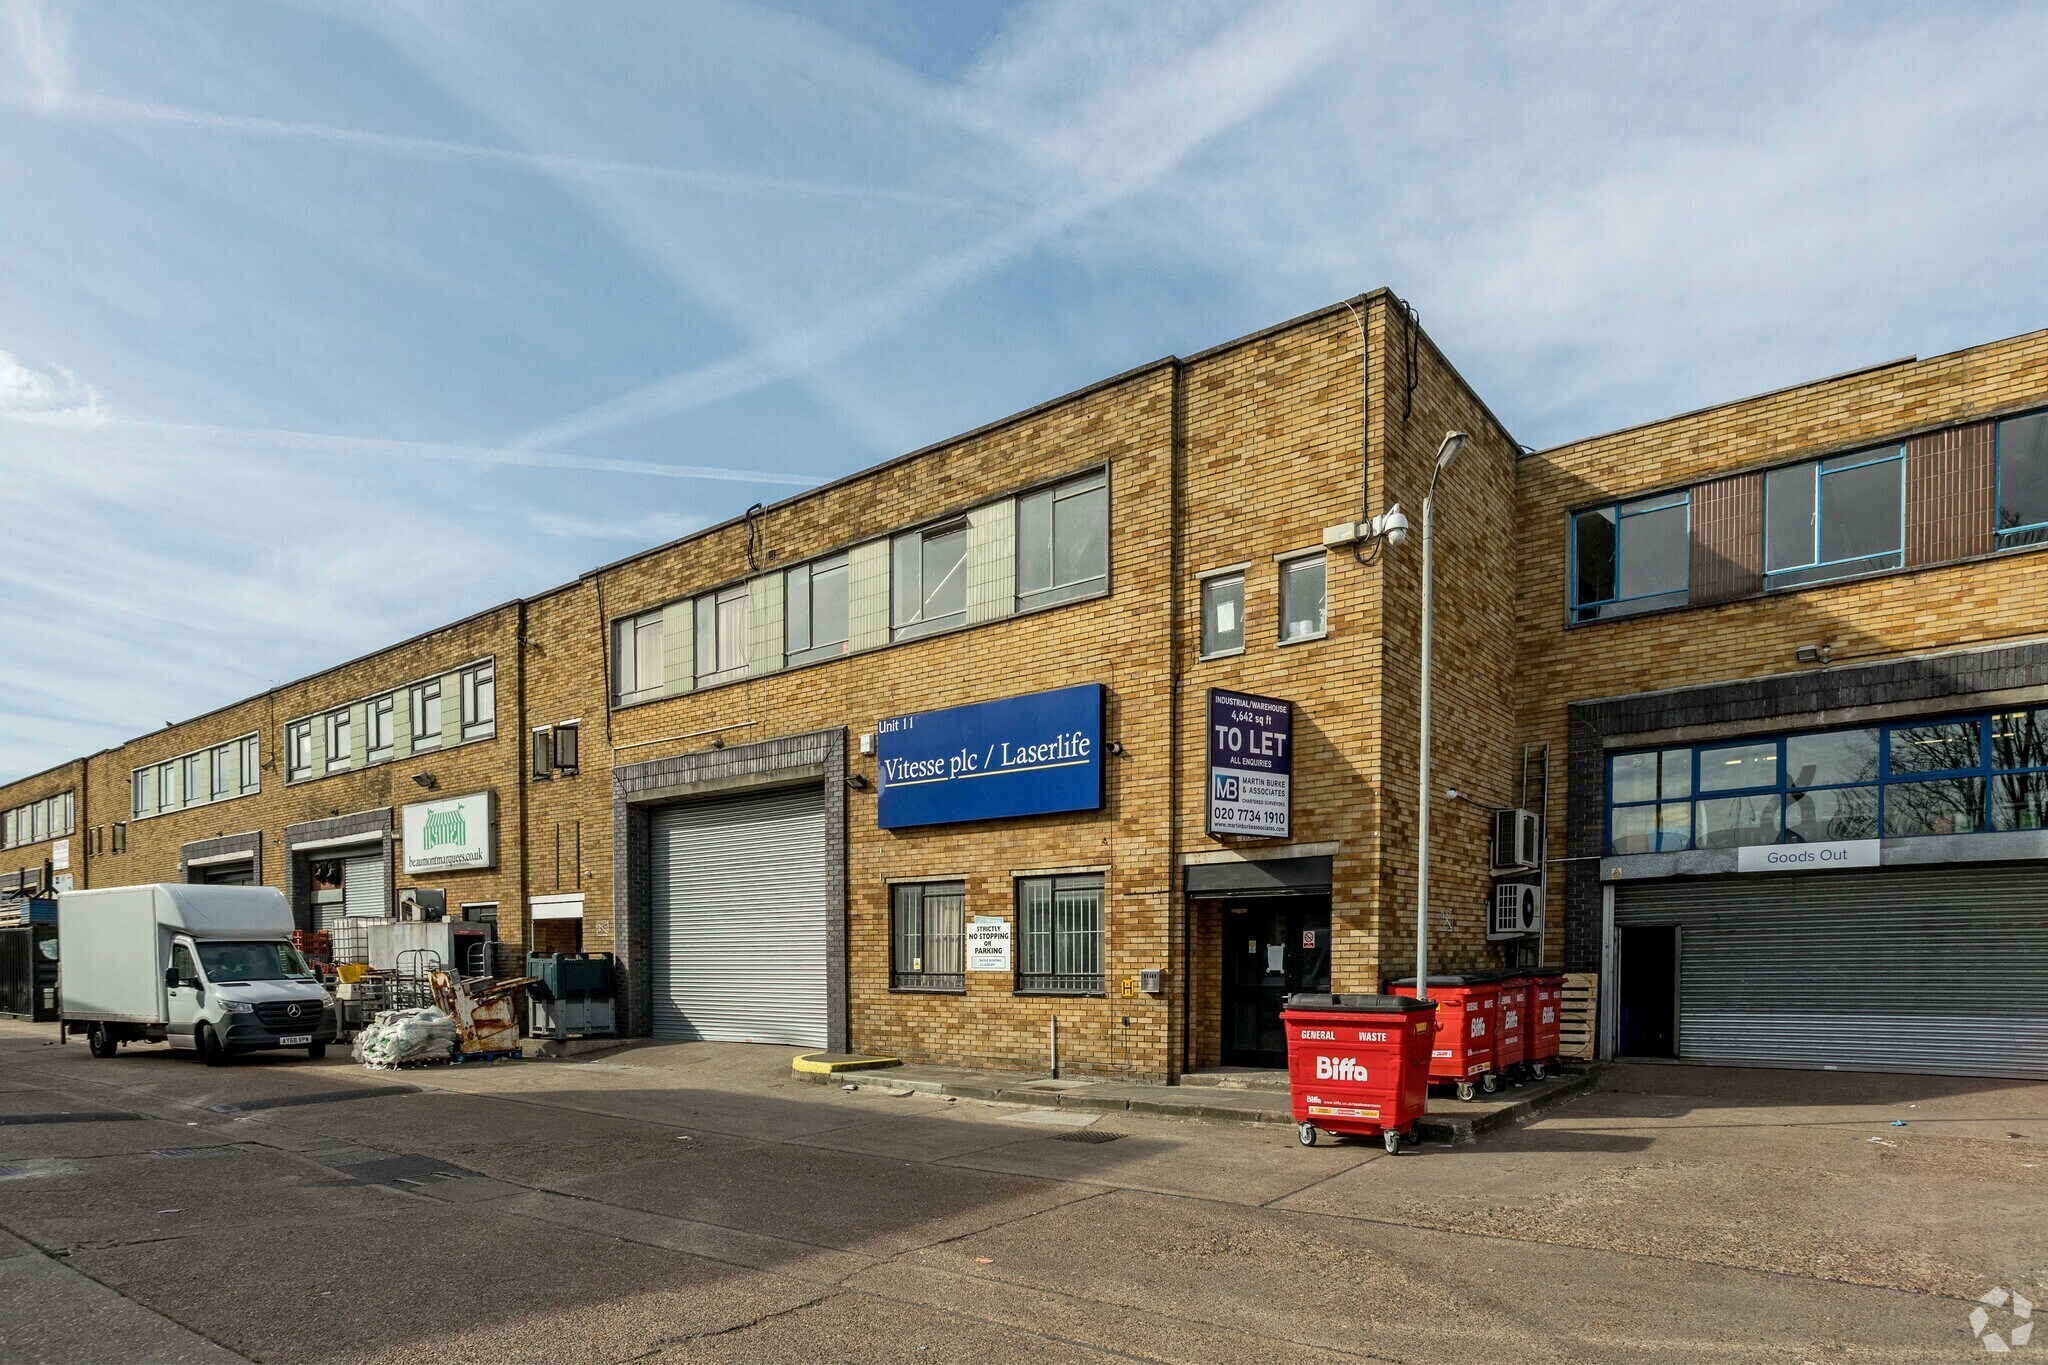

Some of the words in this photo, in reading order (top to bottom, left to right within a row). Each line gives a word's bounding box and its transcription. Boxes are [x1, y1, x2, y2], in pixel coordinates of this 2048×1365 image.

[1215, 695, 1287, 713] INDUSTRIAL/WAREHOUSE
[879, 721, 899, 734] Unit
[902, 717, 914, 730] 11
[1231, 710, 1253, 722] 4,642
[1255, 716, 1264, 726] sq
[1266, 715, 1272, 725] ft
[1215, 725, 1242, 751] TO
[1250, 730, 1287, 757] LET
[884, 757, 945, 781] Vitesse
[949, 748, 978, 779] plc
[1000, 731, 1091, 767] Laserlife
[1230, 756, 1241, 765] ALL
[1242, 757, 1272, 768] ENQUIRIES
[1216, 777, 1238, 799] MB
[1242, 777, 1265, 786] MARTIN
[1266, 780, 1286, 788] BURKE
[1249, 787, 1286, 797] ASSOCIATES
[1214, 807, 1234, 820] 020
[1237, 809, 1261, 822] 7734
[1264, 811, 1285, 824] 1910
[1214, 822, 1286, 832] www.martinburkeassociates.com
[408, 847, 483, 867] beaumontmarquees.co.uk
[1767, 851, 1815, 863] Goods
[1820, 849, 1848, 860] Out
[1301, 1030, 1335, 1040] GENERAL
[1358, 1032, 1387, 1042] WASTE
[1316, 1056, 1368, 1081] Biffa
[1306, 1095, 1322, 1104] Biffa
